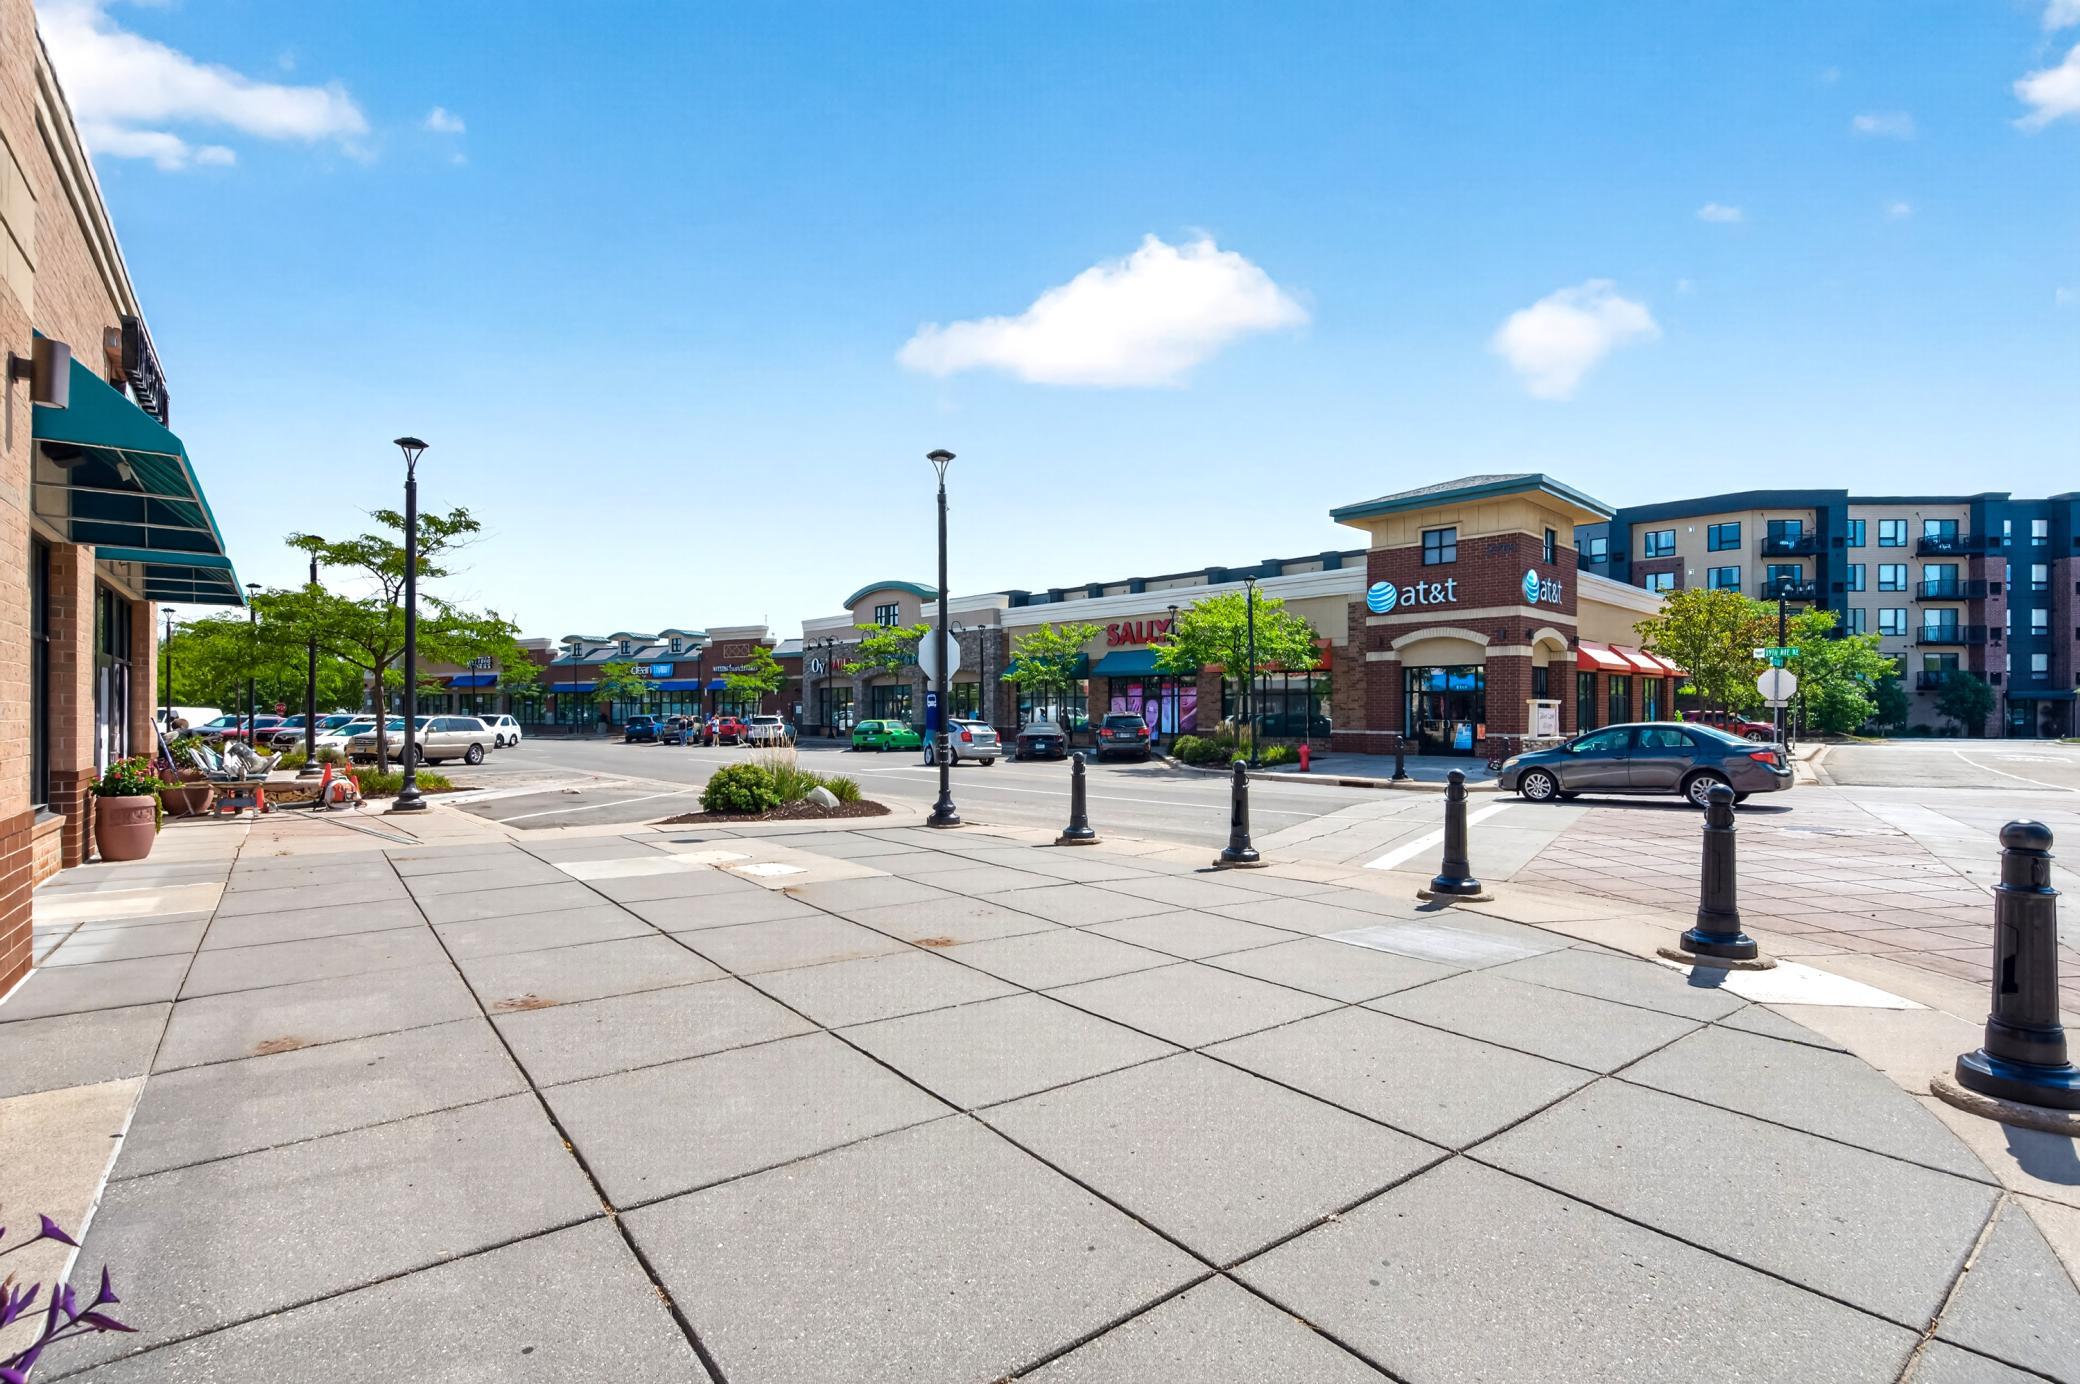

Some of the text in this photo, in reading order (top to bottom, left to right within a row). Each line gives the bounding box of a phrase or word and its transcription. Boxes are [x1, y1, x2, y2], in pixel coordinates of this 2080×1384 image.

[1400, 577, 1457, 606] at&t
[1540, 577, 1562, 605] at&t
[1107, 619, 1172, 647] SALLY
